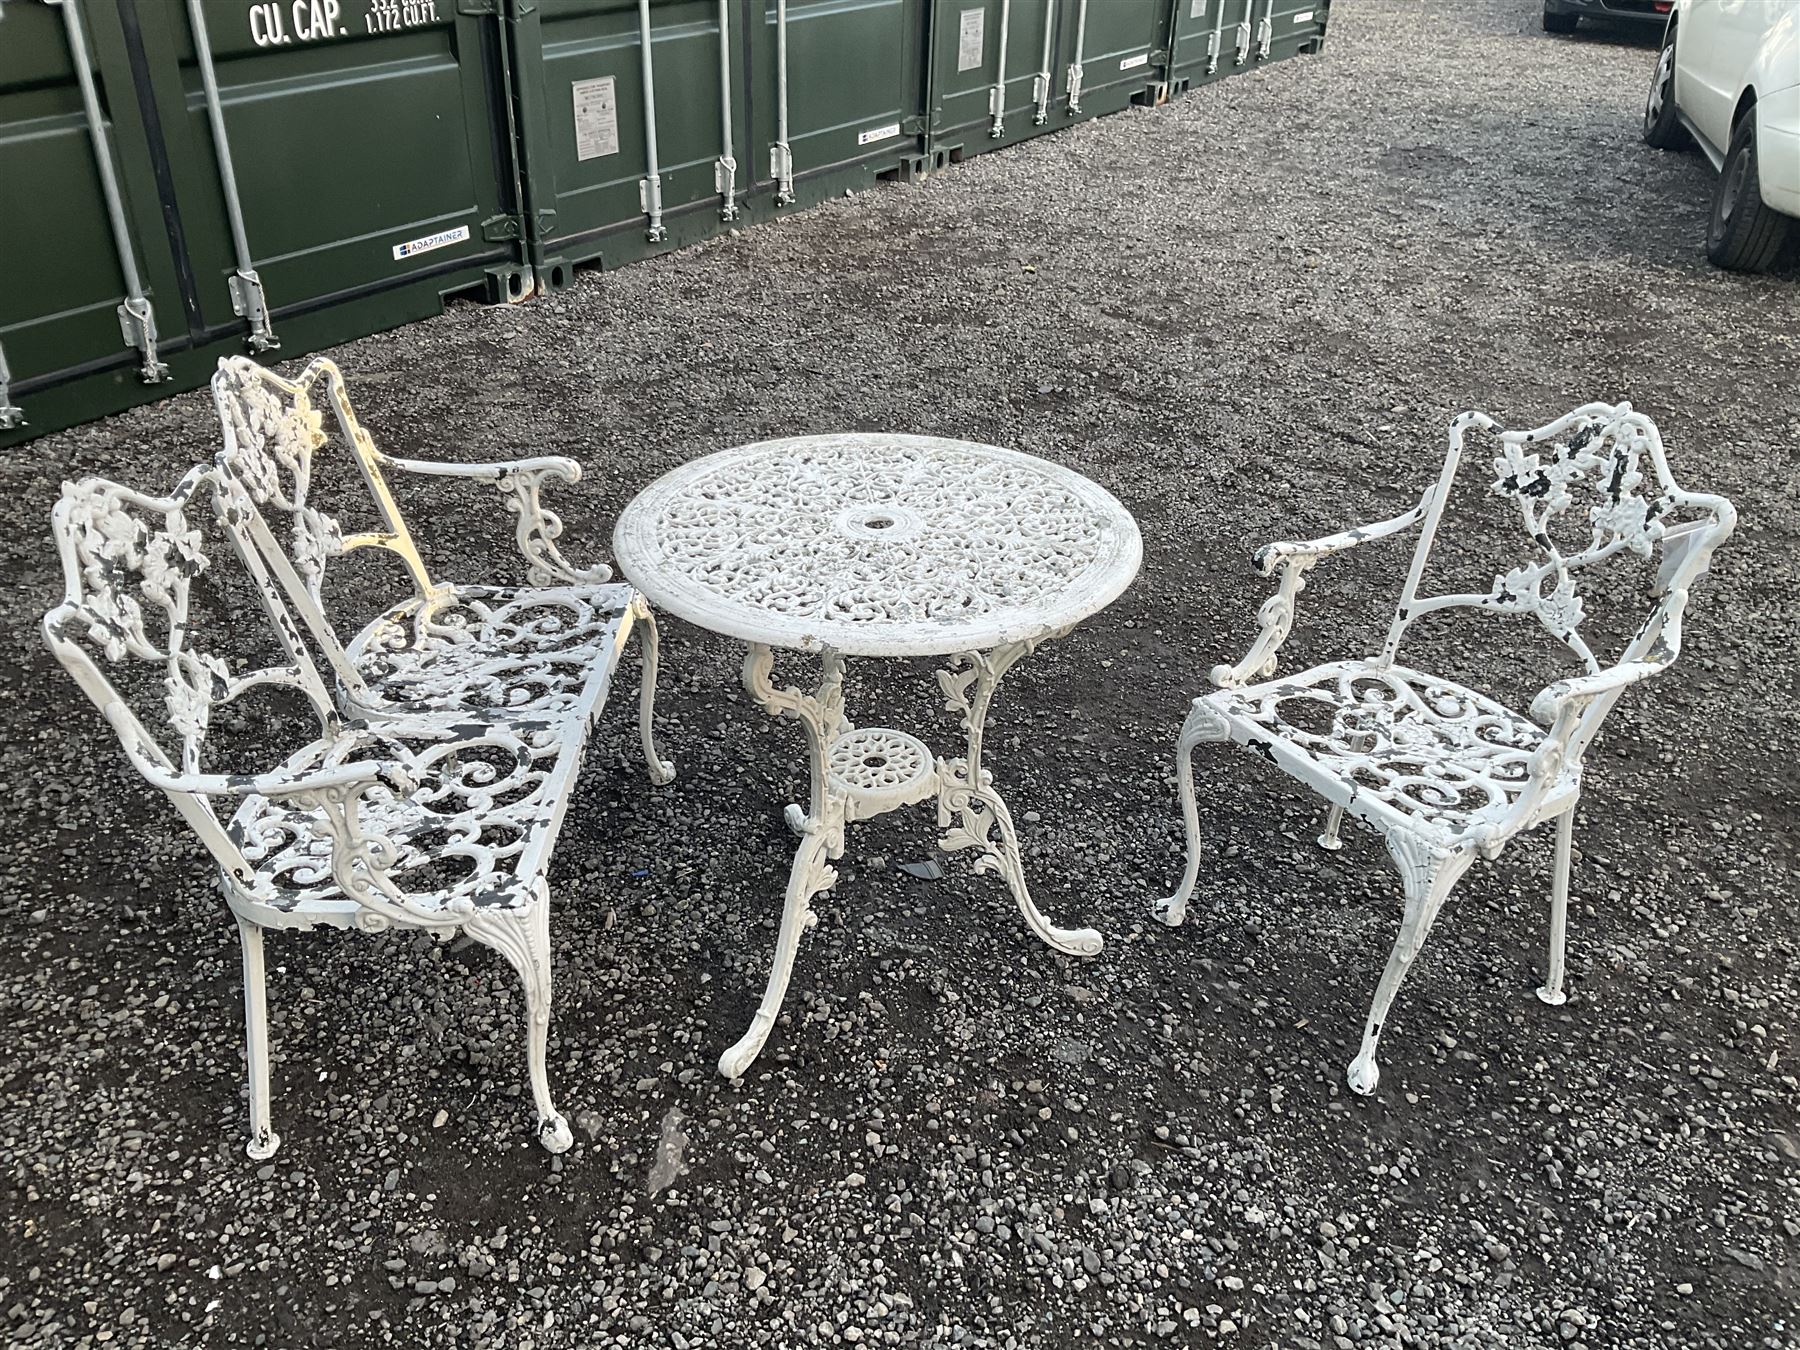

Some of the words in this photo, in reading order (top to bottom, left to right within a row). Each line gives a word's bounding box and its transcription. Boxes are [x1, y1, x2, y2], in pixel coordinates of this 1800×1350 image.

[249, 2, 290, 46] CU.
[292, 0, 348, 40] CAP.
[365, 9, 401, 34] 1.172
[403, 2, 441, 26] CU.FT.
[412, 231, 463, 251] ADAPTAINER
